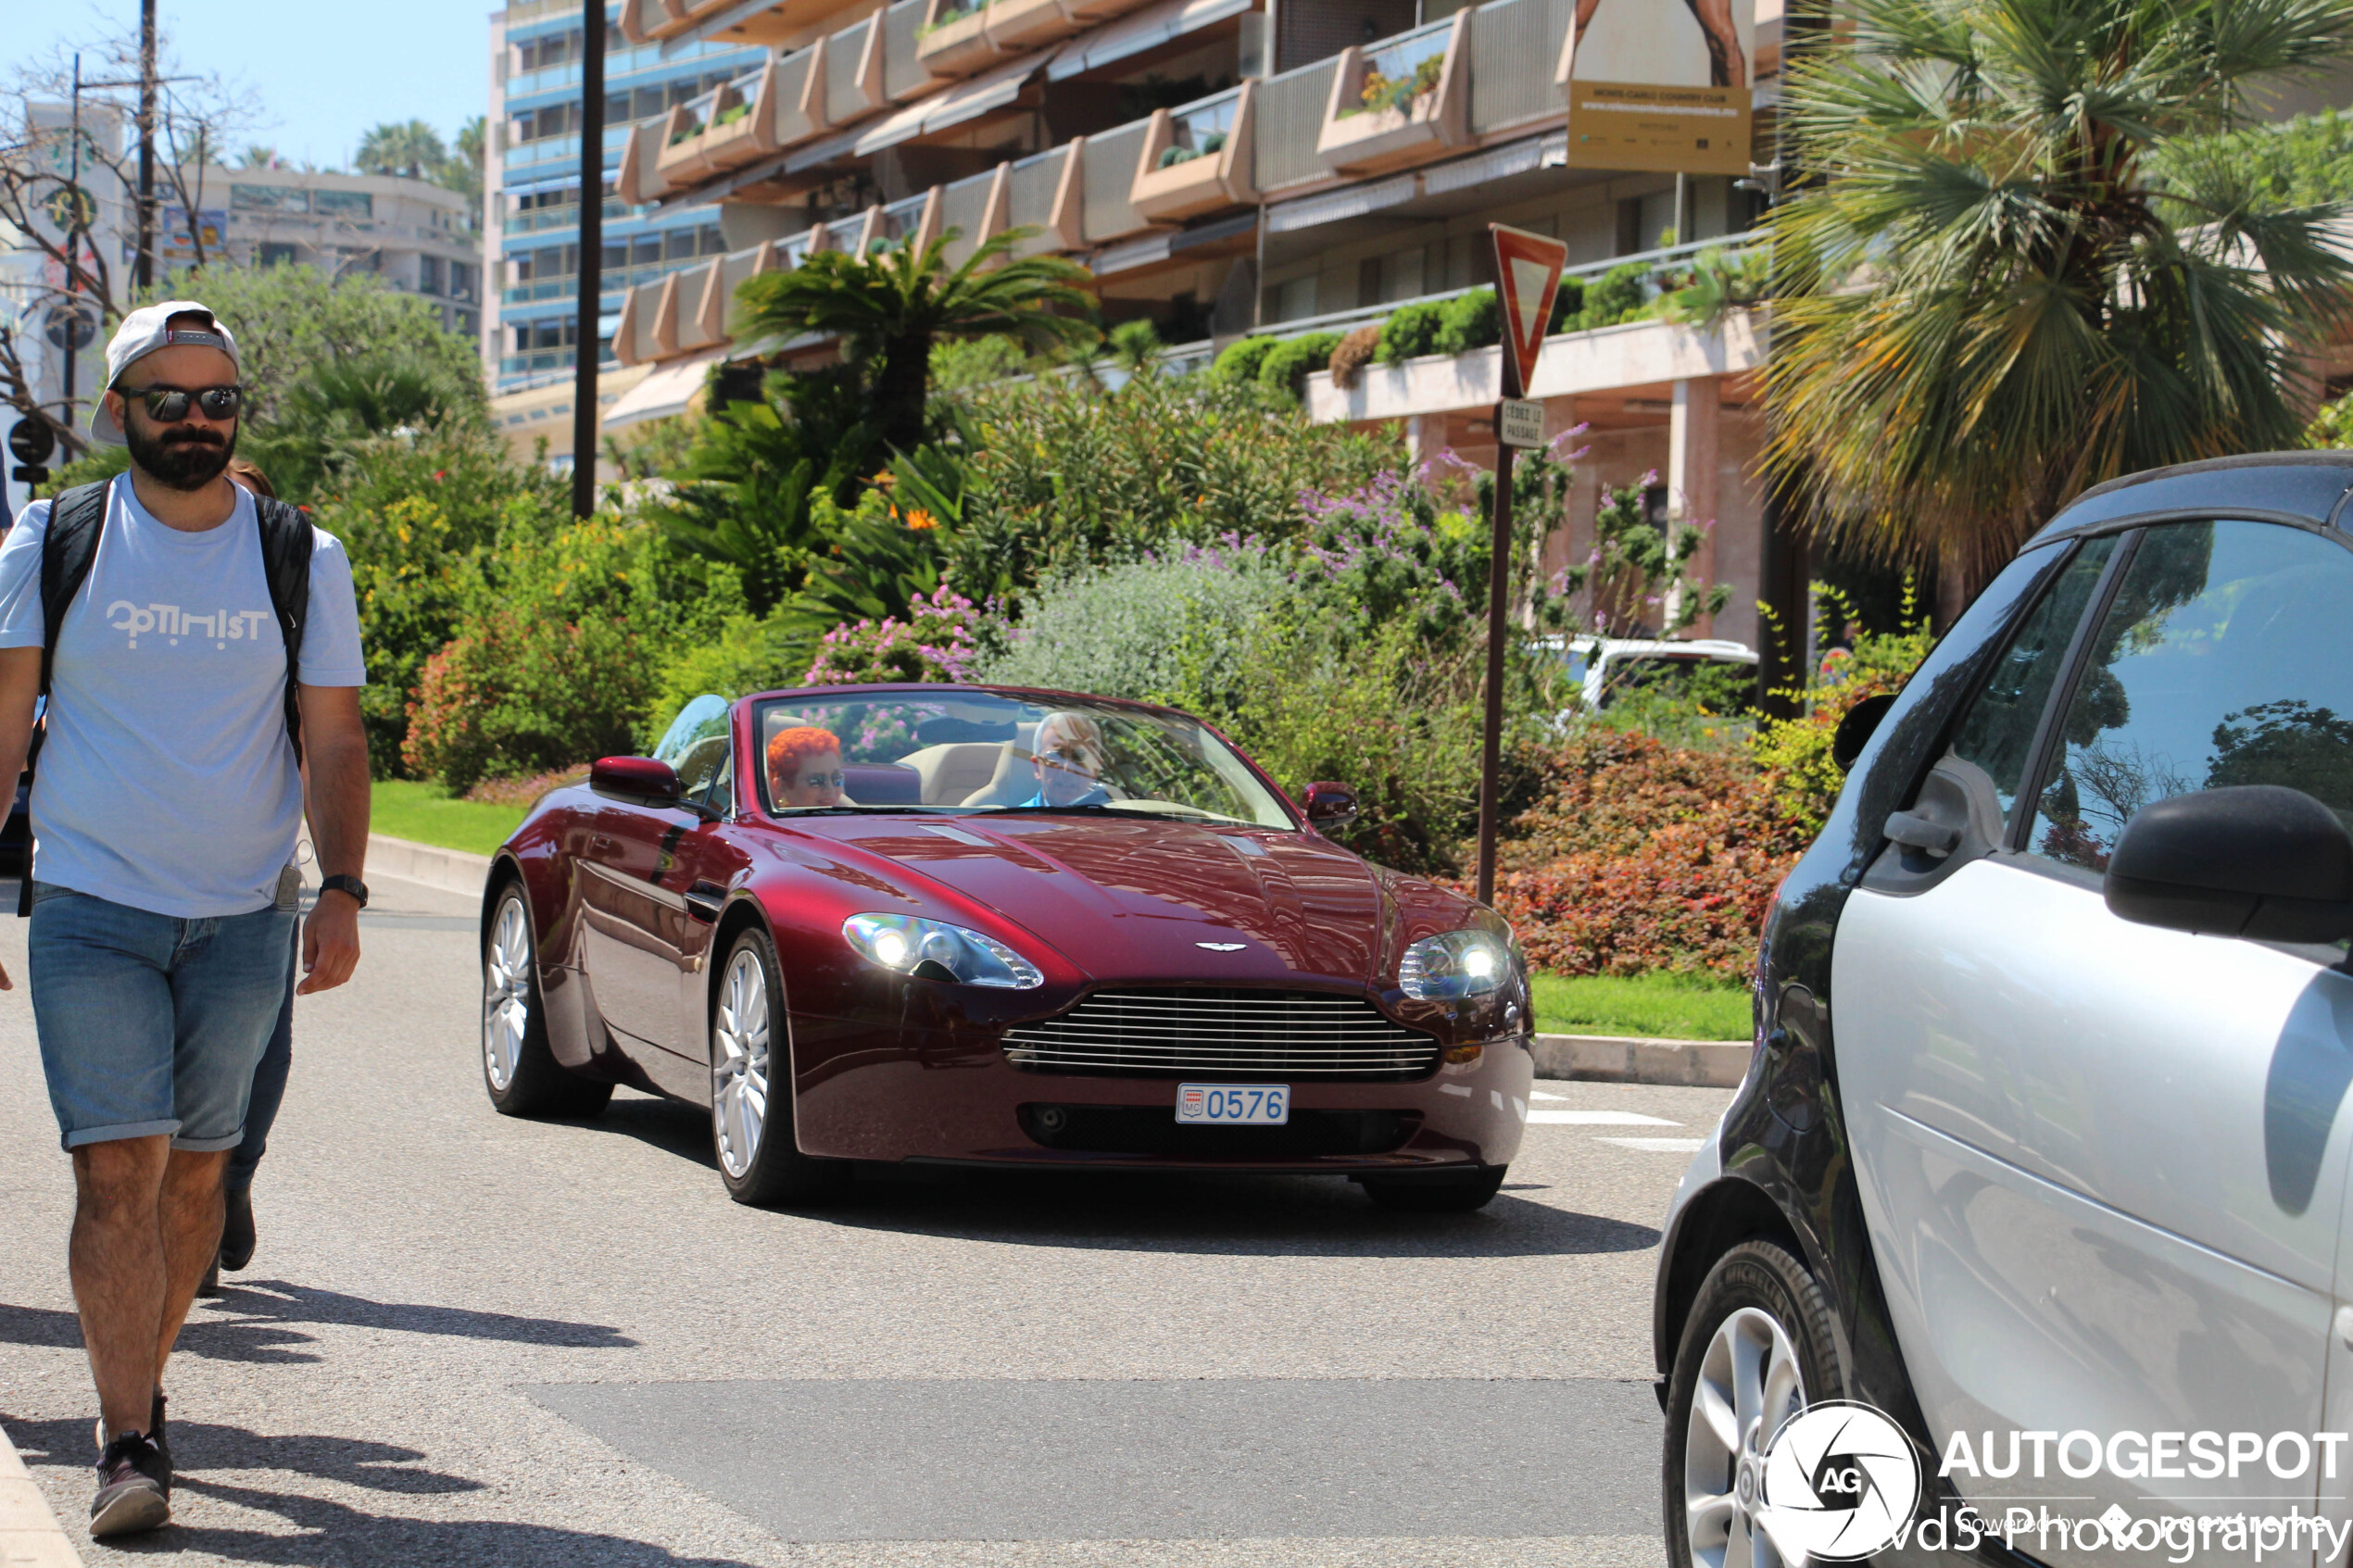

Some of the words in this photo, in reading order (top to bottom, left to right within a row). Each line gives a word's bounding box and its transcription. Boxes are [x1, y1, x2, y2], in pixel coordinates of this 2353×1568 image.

[1507, 423, 1539, 440] PASSAGE
[1185, 1103, 1201, 1112] MC
[1207, 1090, 1283, 1119] 0576
